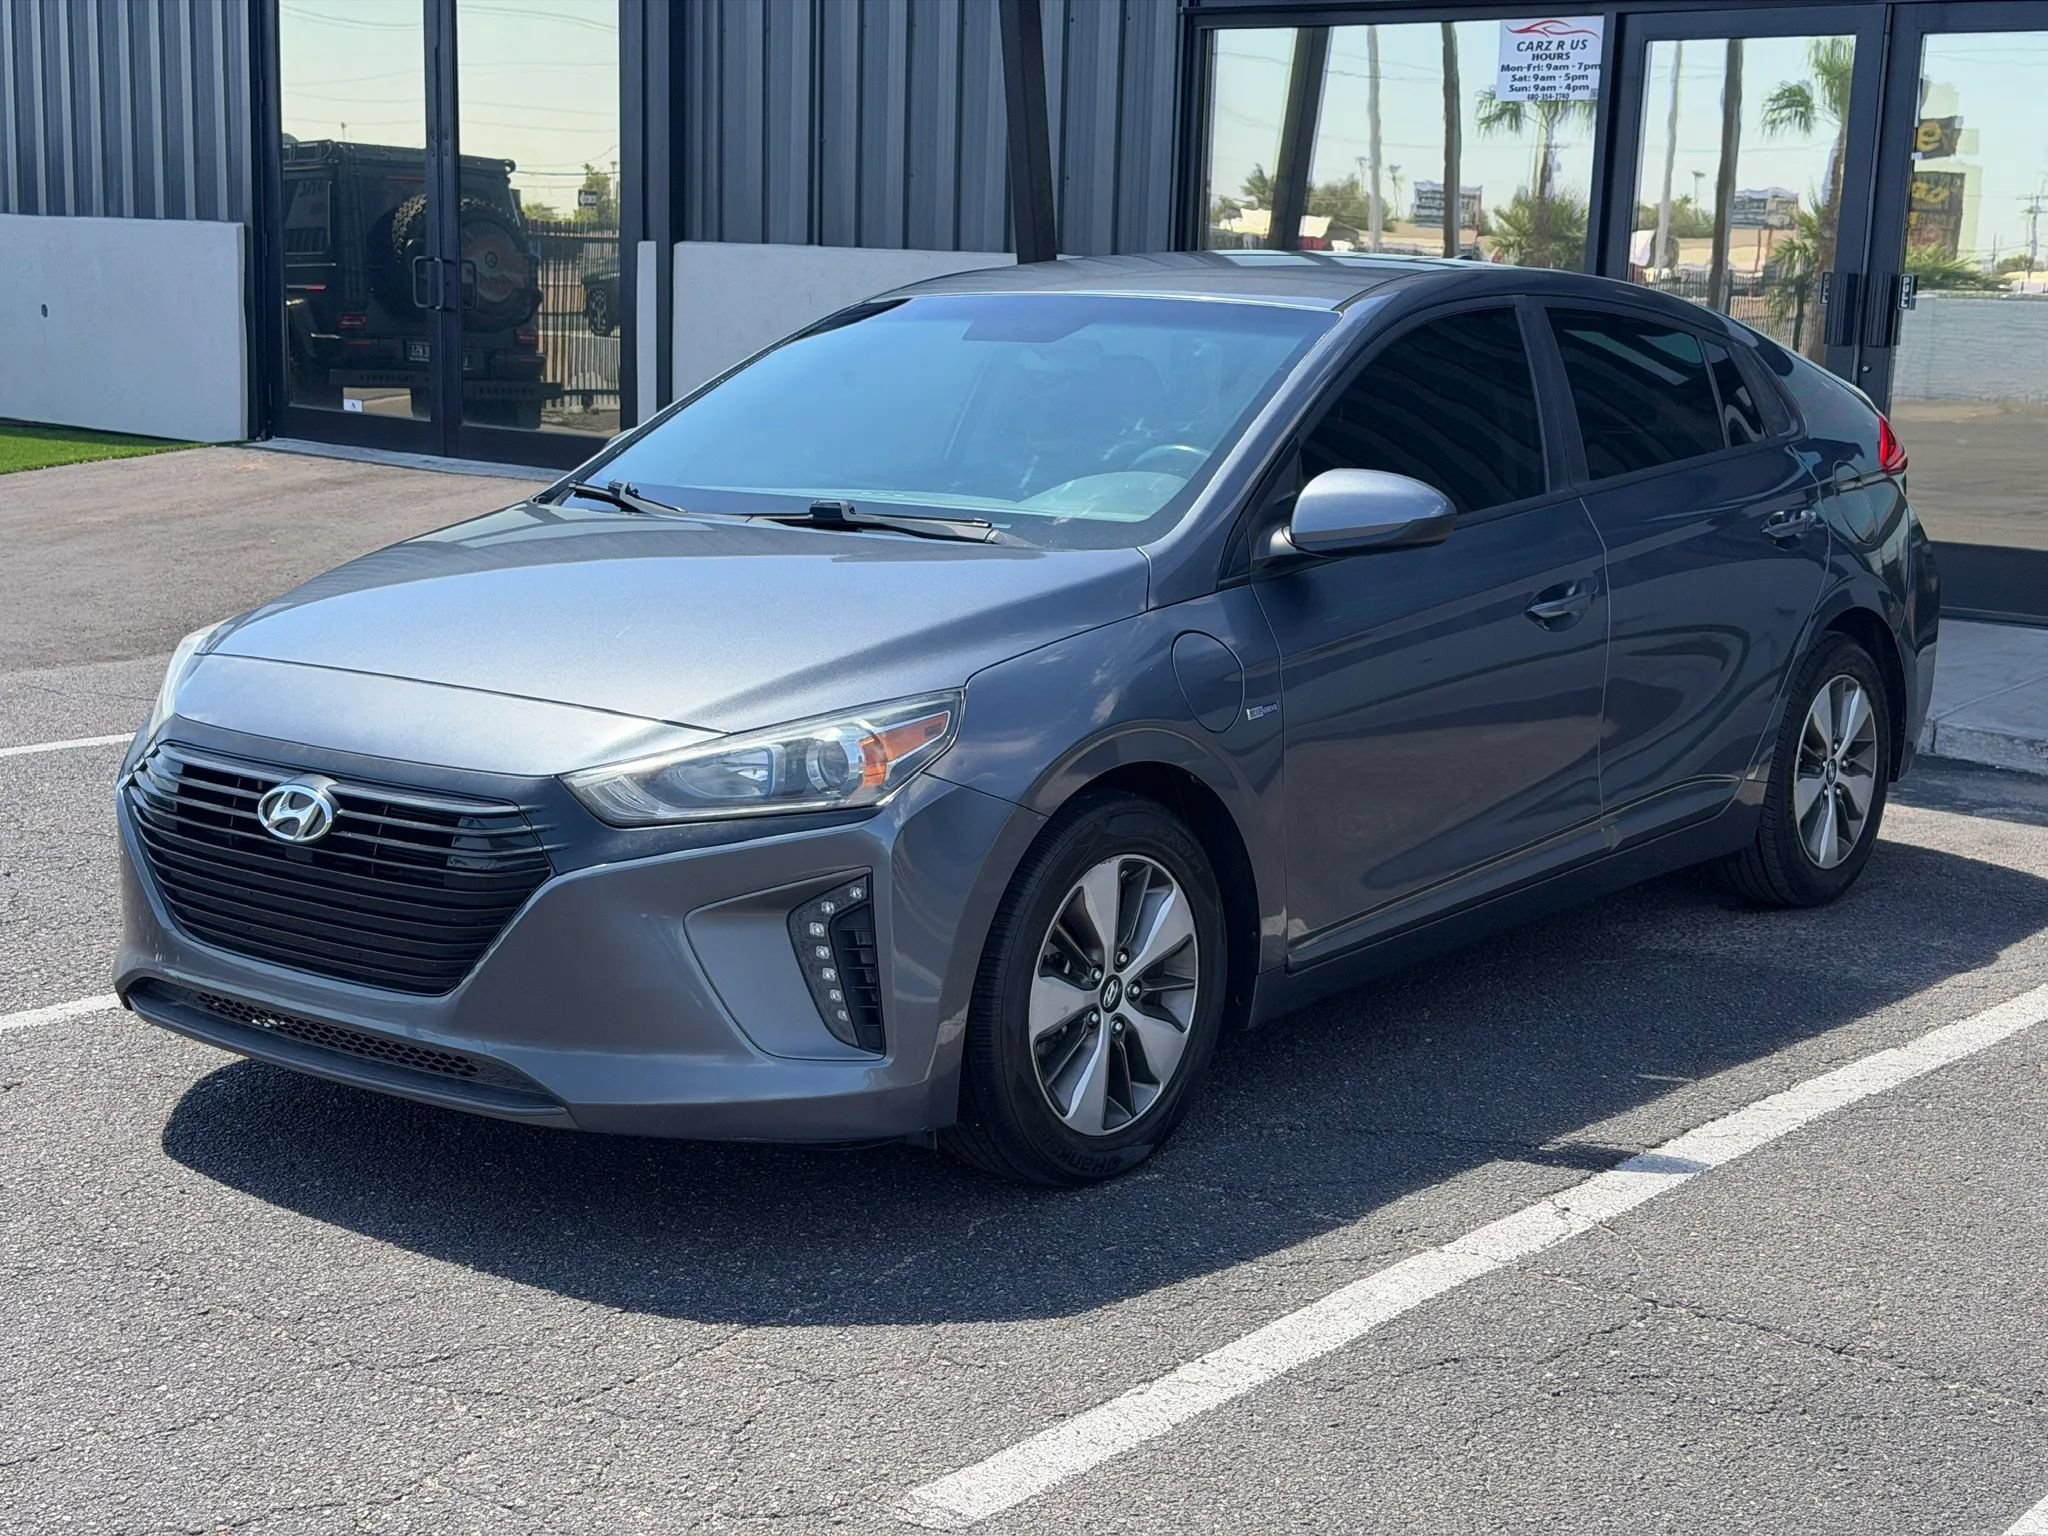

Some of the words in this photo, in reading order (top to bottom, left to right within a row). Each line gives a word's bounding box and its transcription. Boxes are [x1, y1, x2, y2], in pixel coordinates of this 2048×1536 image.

[1517, 41, 1553, 52] CARZ
[1556, 40, 1566, 51] R
[1570, 39, 1588, 50] US
[1531, 52, 1571, 61] HOURS
[1500, 63, 1544, 72] Mon-Fri:
[1545, 63, 1569, 71] 9am
[1577, 62, 1601, 72] 7pm
[1511, 74, 1531, 82] Sat:
[1532, 74, 1556, 82] 9am
[1564, 73, 1588, 82] 5pm
[1509, 84, 1531, 92] Sun:
[1532, 84, 1556, 92] 9am
[1564, 83, 1589, 92] 4pm
[1901, 277, 1910, 307] PULL
